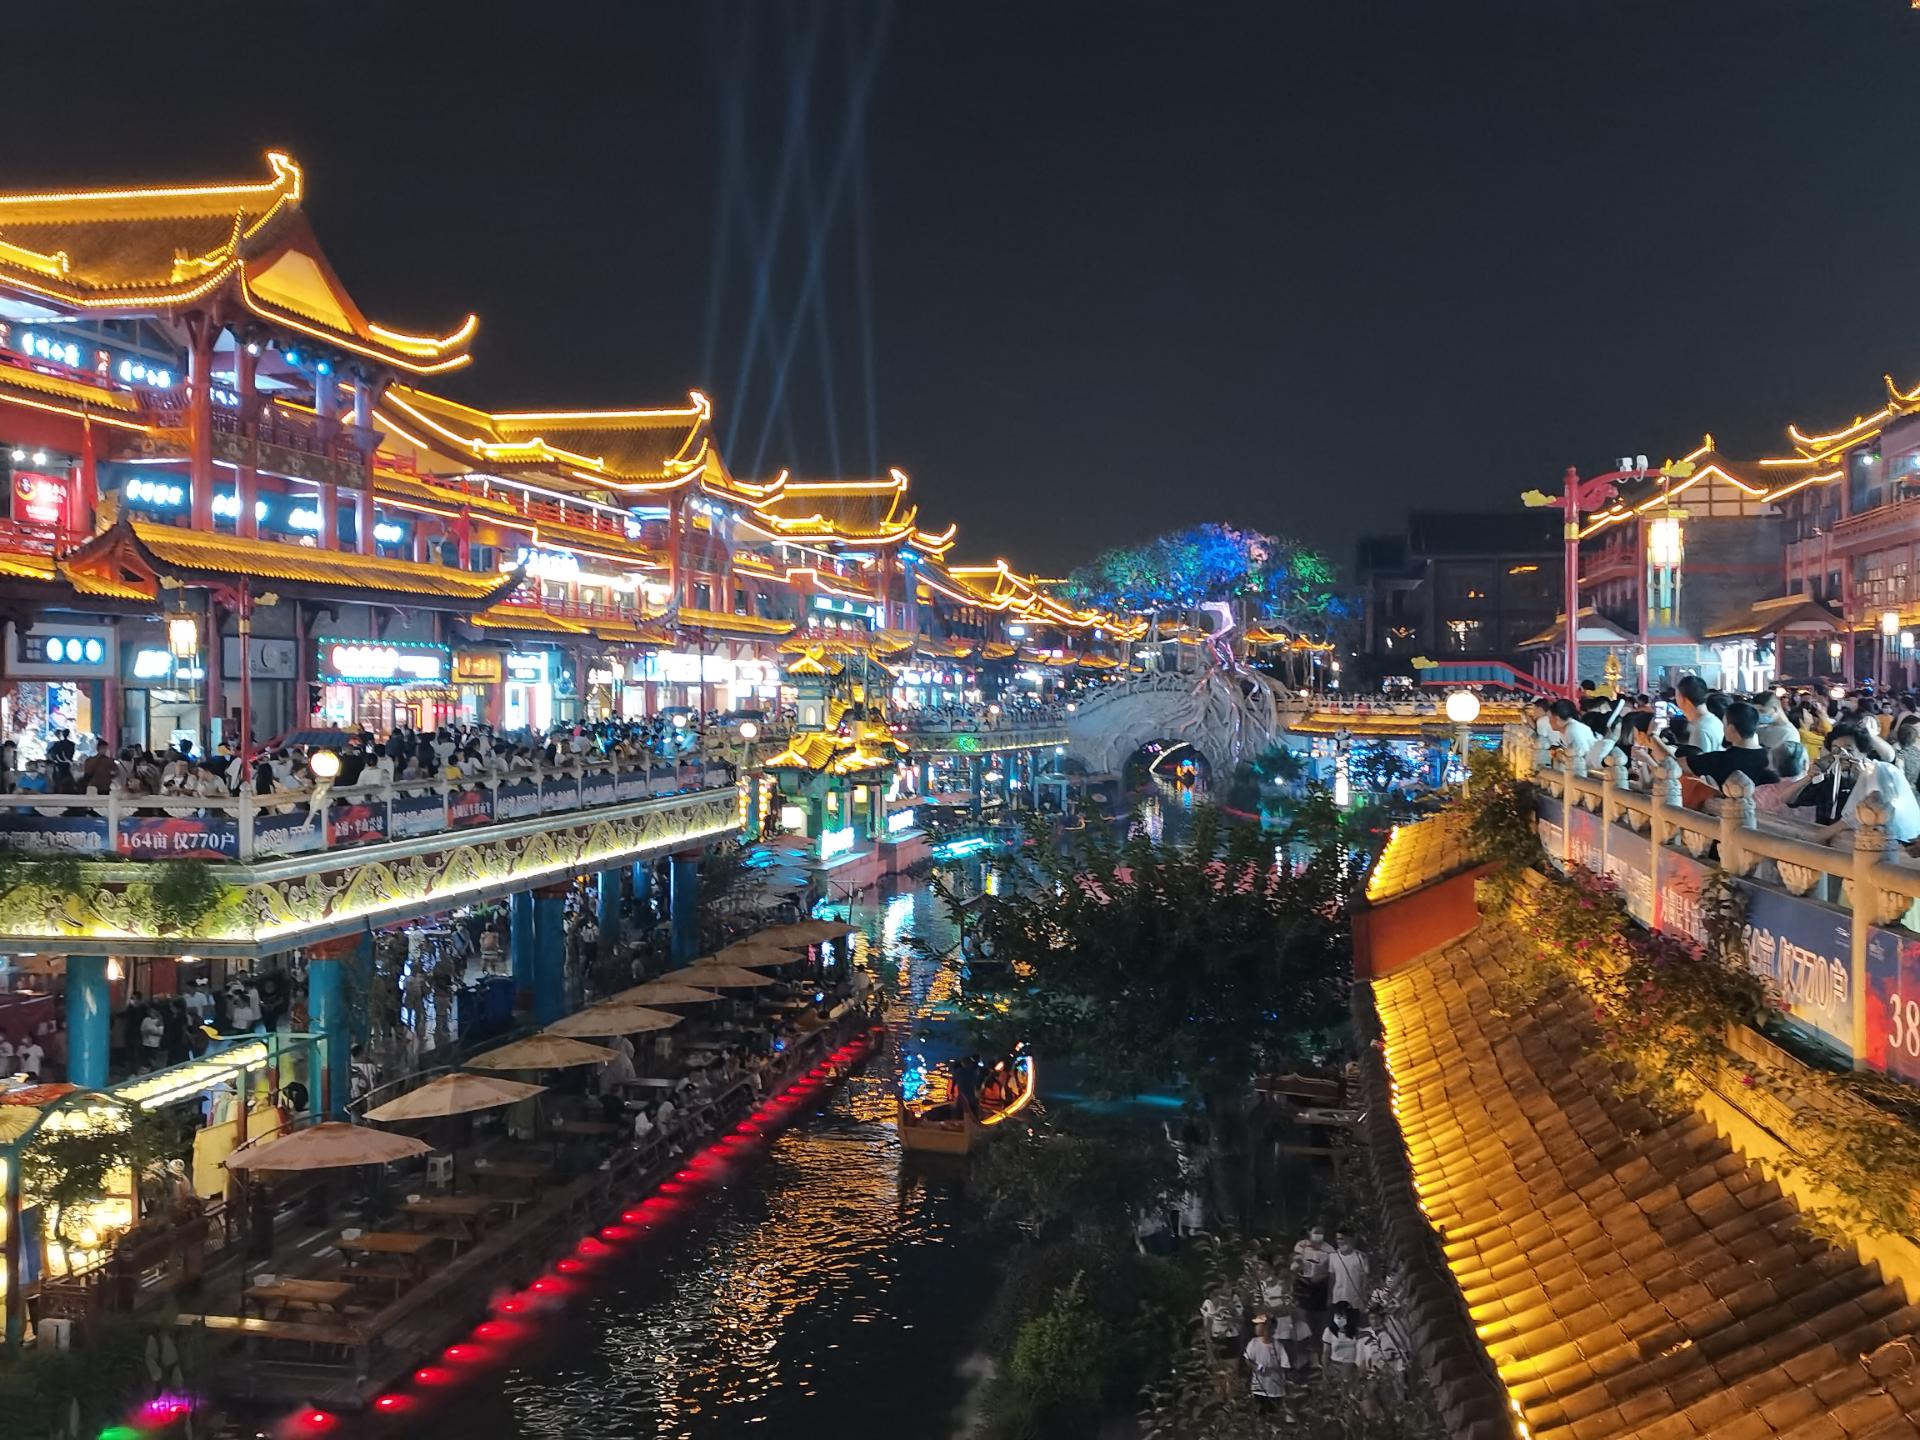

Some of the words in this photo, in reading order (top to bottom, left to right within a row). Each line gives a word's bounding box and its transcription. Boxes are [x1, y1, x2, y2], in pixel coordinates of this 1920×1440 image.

[121, 831, 168, 849] 164亩
[173, 831, 236, 849] 仅770户
[1888, 993, 1920, 1057] 38
